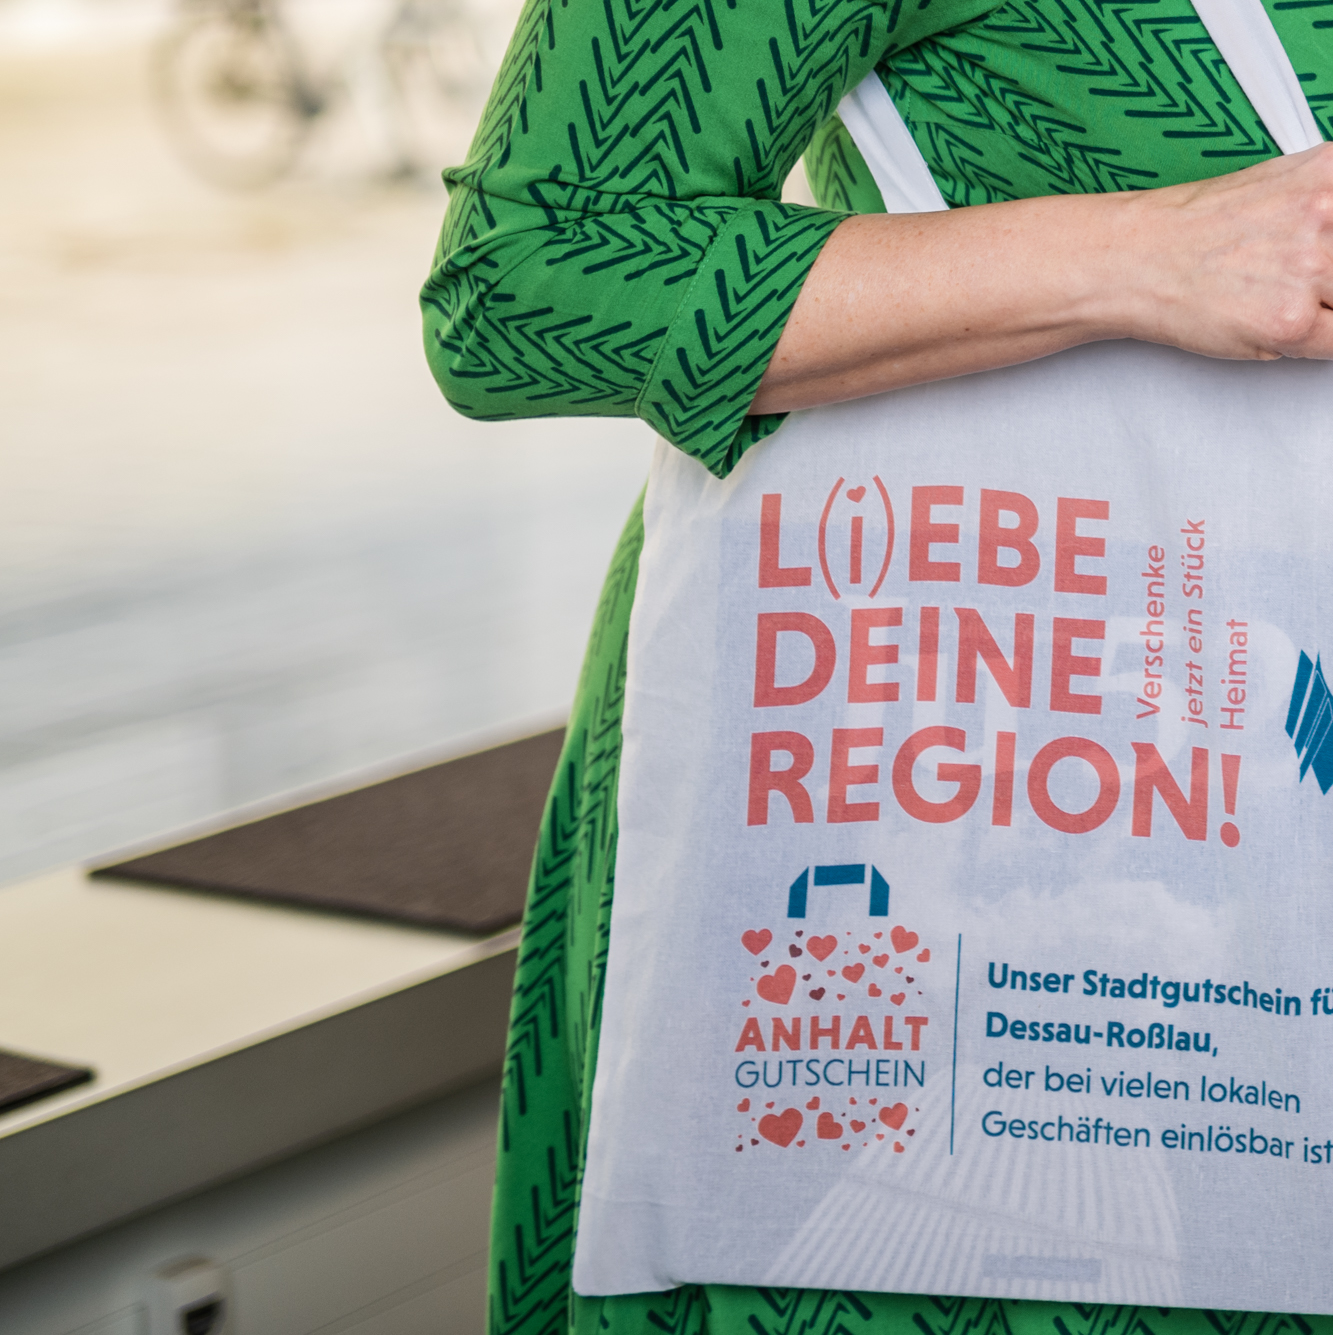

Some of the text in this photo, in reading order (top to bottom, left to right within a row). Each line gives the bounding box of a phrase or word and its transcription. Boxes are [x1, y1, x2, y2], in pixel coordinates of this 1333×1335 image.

[1136, 546, 1164, 719] Verschenke
[1181, 520, 1208, 728] jetzt ein Stück
[754, 607, 1105, 714] DEINE
[1220, 619, 1247, 729] Heimat
[747, 726, 1240, 847] REGION!
[988, 962, 1074, 993] Unser
[1083, 970, 1301, 1015] Stadtgutschein
[735, 1016, 928, 1052] ANHALT
[986, 1012, 1217, 1057] Dessau-Roßlau,
[735, 1059, 924, 1088] GUTSCHEIN
[983, 1062, 1300, 1113] der bei vielen lokalen
[982, 1111, 1150, 1147] Geschäften
[1161, 1124, 1294, 1158] einlösbar
